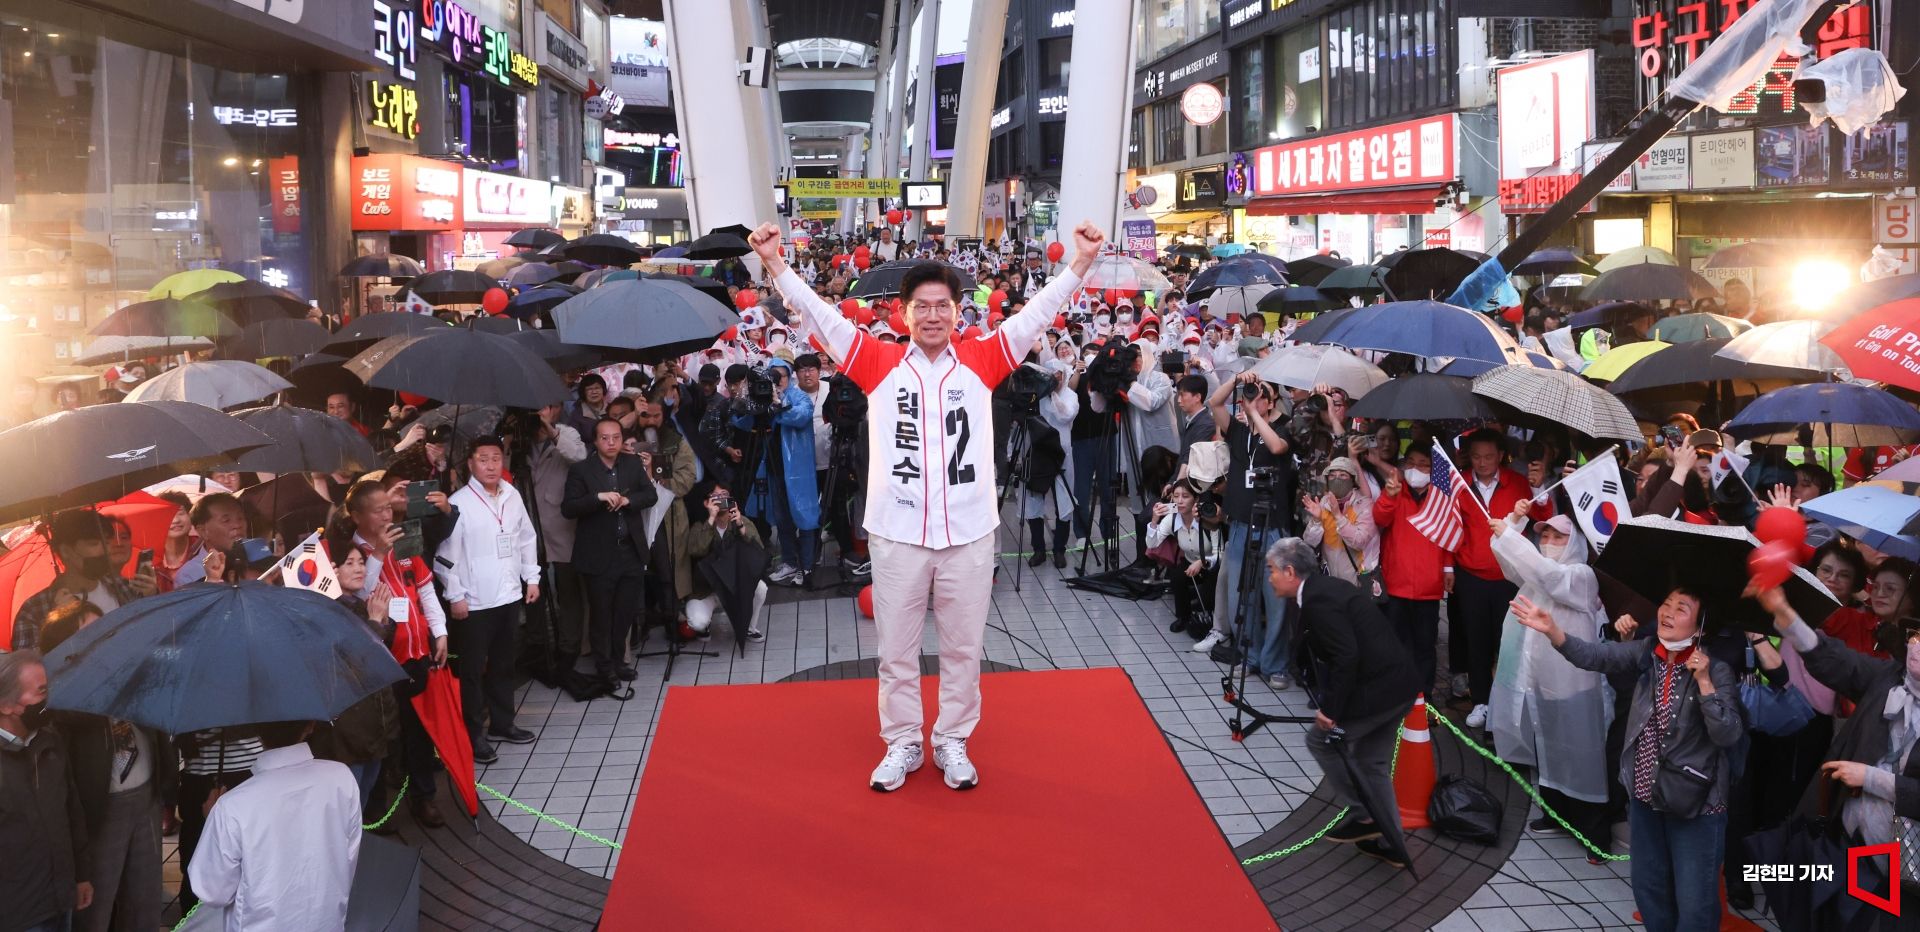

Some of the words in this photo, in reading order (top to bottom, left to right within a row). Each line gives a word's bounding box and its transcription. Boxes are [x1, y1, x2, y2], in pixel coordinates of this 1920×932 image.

[374, 0, 416, 81] 코인
[485, 26, 510, 86] 코인
[1186, 58, 1205, 74] DESSERT
[1205, 52, 1218, 67] CAFE
[372, 80, 418, 140] 노래방
[1700, 137, 1746, 154] 르미안헤어
[1651, 147, 1686, 165] 헌혈의집
[361, 168, 391, 182] 보드
[361, 184, 391, 200] 게임
[797, 181, 805, 189] 이
[808, 181, 831, 190] 구간은
[361, 201, 391, 215] Cafe
[626, 198, 658, 209] YOUNG
[1868, 324, 1902, 341] Golf
[1854, 338, 1868, 349] #1
[1882, 348, 1899, 361] on
[945, 406, 976, 486] 2
